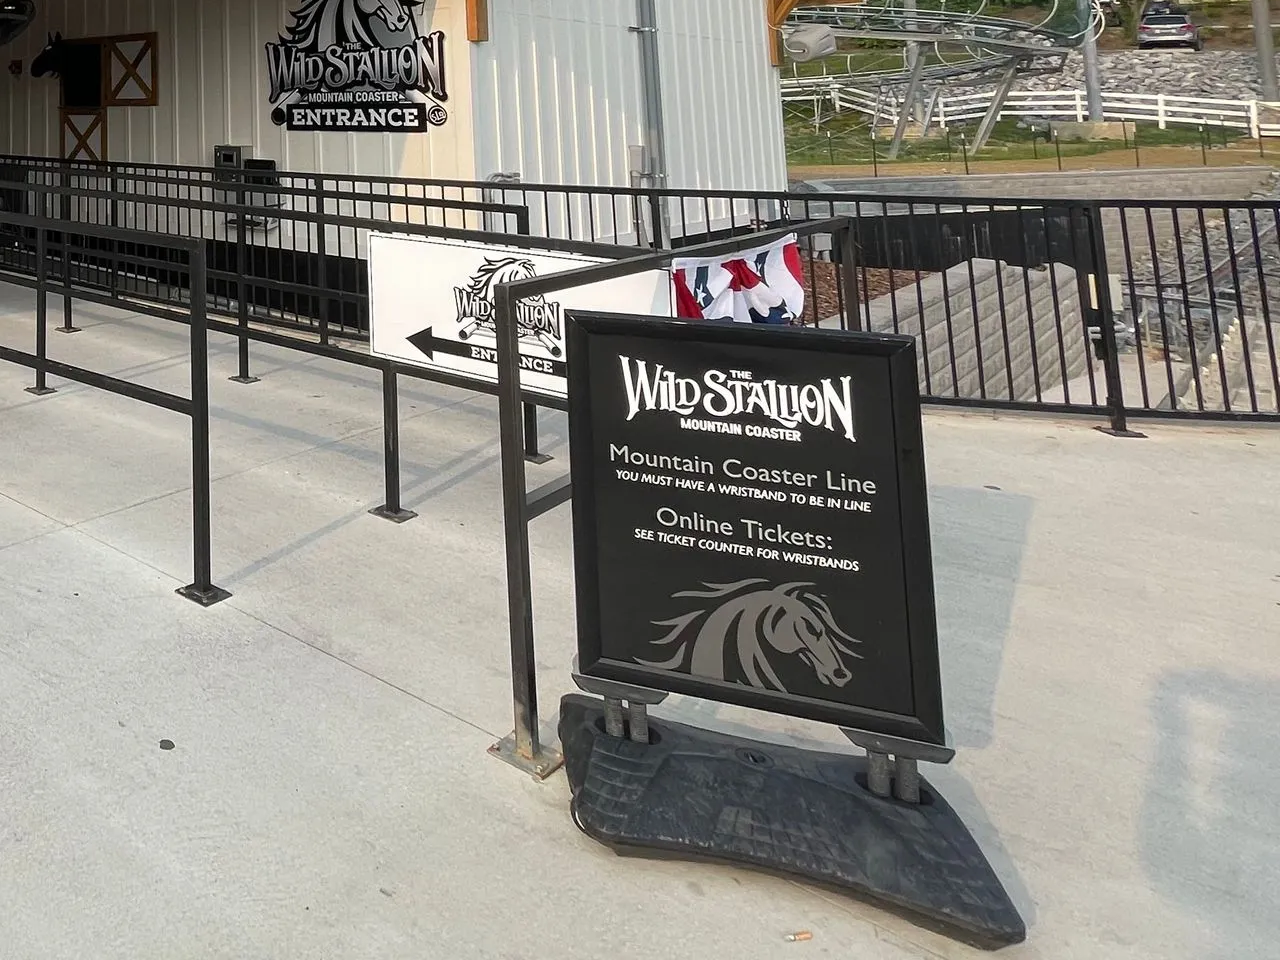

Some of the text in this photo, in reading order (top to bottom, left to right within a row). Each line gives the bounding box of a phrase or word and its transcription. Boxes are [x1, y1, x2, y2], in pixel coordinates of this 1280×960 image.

[344, 42, 362, 51] THE
[266, 31, 445, 102] WILD STALLION
[308, 91, 399, 103] MOUNTAIN COASTER
[292, 107, 419, 127] ENTRANCE
[471, 345, 554, 373] ENTNCE
[728, 369, 753, 381] THE
[618, 354, 857, 443] WILD STALLION
[679, 418, 802, 443] MOUNTAIN COASTER
[609, 443, 877, 495] Mountain Coaster Line
[615, 469, 872, 514] YOU MUST HAVE A WRISTBAND TO BE IN LINE
[656, 507, 833, 551] Online Tickets:
[634, 528, 860, 573] SEE TICKET COUNTER FOR WRISTBANDS
